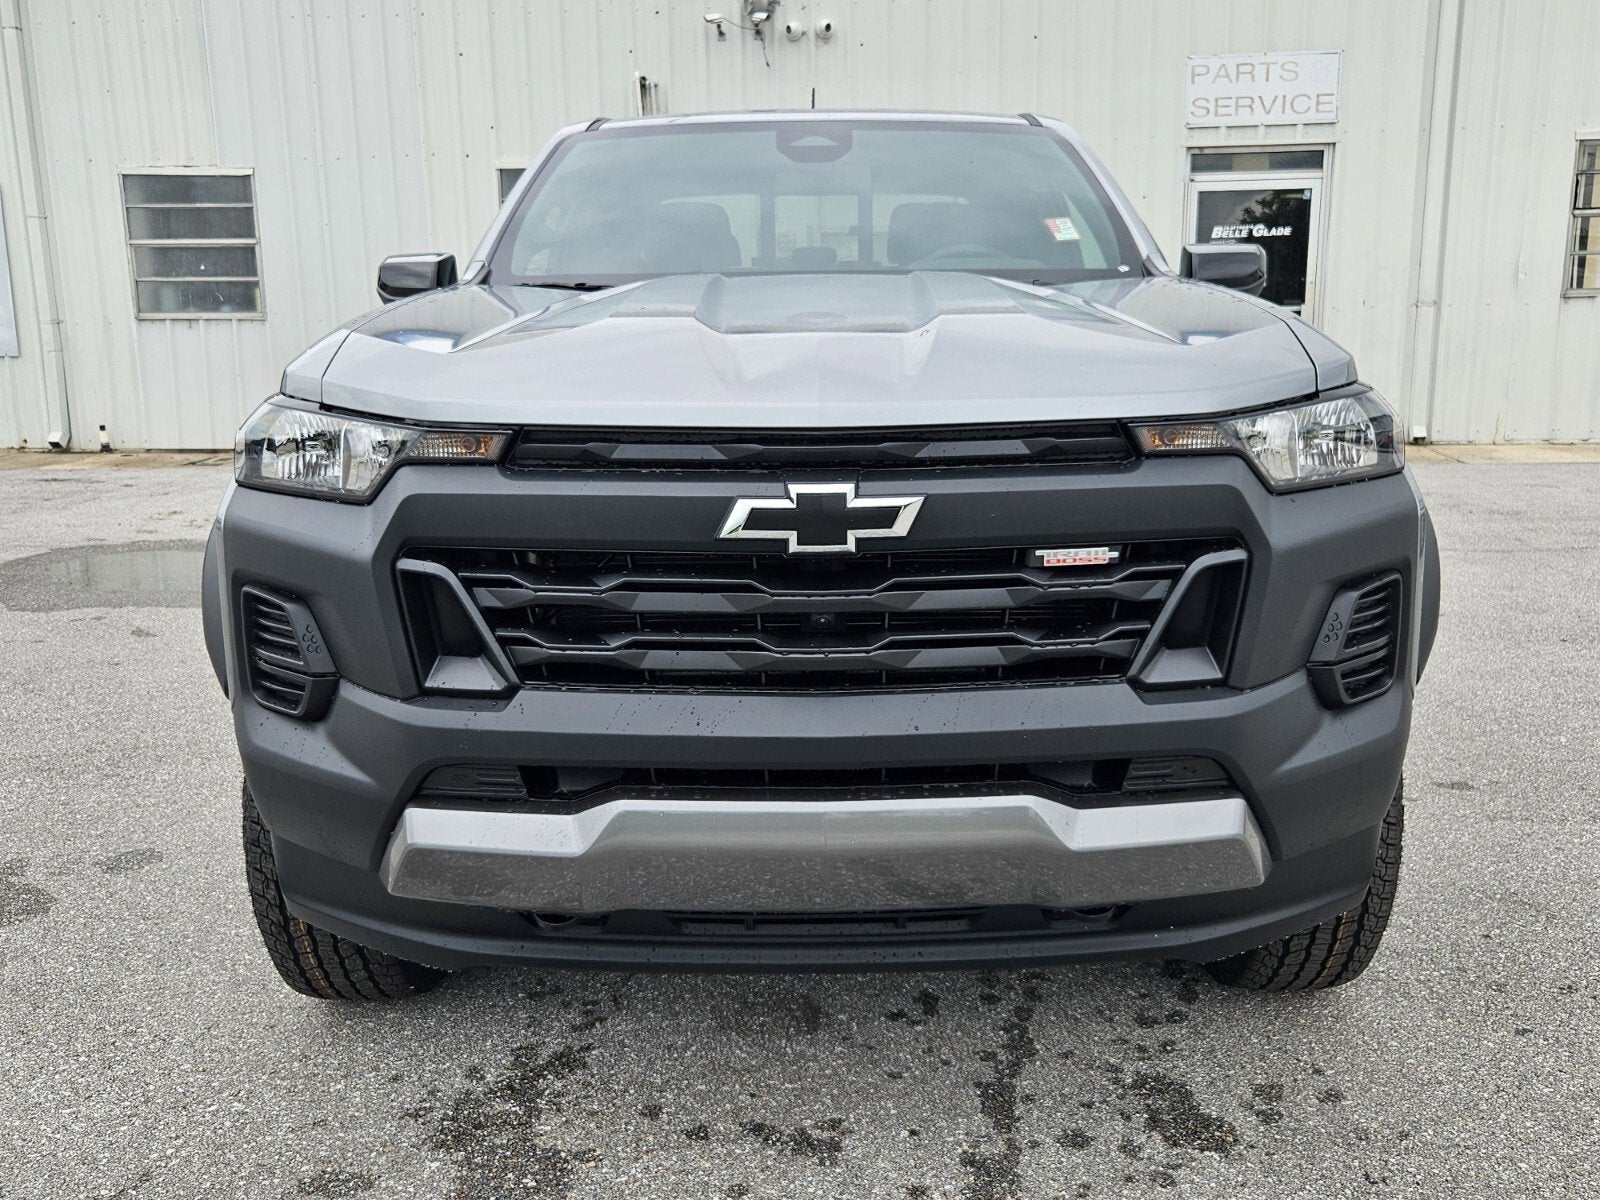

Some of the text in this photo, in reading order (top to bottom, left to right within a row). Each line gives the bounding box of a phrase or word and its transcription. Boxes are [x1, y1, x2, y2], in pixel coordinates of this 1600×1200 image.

[1190, 61, 1299, 85] PARTS
[1190, 93, 1335, 118] SERVICE
[1252, 223, 1293, 237] GLADE
[1035, 547, 1119, 558] TRAIL
[1045, 556, 1108, 565] BOSS
